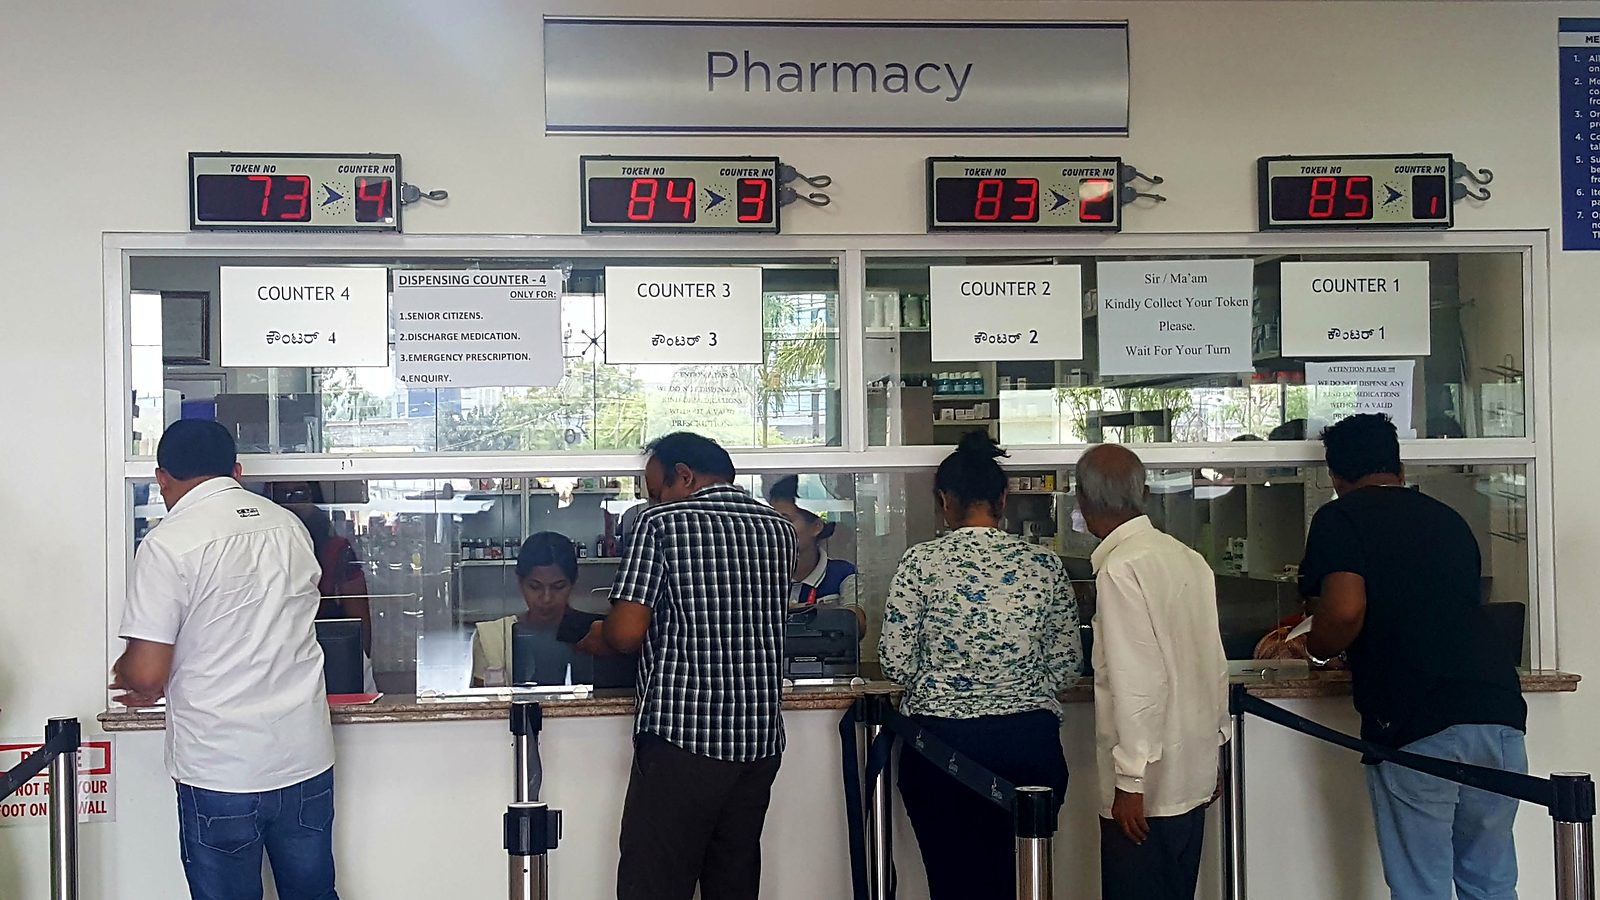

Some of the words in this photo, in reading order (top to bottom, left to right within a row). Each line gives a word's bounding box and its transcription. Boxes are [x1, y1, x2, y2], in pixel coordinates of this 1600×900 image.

[706, 49, 974, 102] Pharmacy
[1574, 77, 1582, 85] 2.
[1574, 110, 1583, 118] 3.
[1589, 121, 1600, 129] pr
[1575, 133, 1584, 141] 4.
[1575, 155, 1584, 164] 5.
[230, 164, 260, 174] TOKEN
[262, 164, 276, 174] NO
[338, 164, 379, 174] COUNTER
[381, 165, 395, 174] NO
[621, 166, 650, 176] TOKEN
[652, 167, 665, 176] NO
[719, 168, 759, 178] COUNTER
[761, 168, 774, 178] NO
[964, 168, 993, 176] TOKEN
[994, 168, 1007, 176] NO
[1062, 168, 1101, 178] COUNTER
[1102, 168, 1115, 178] NO
[1300, 166, 1328, 175] TOKEN
[1329, 166, 1342, 175] NO
[1394, 165, 1433, 174] COUNTER
[1434, 165, 1446, 174] NO
[247, 175, 310, 219] 73
[358, 177, 388, 218] 4
[1308, 177, 1369, 218] 85
[1576, 188, 1585, 196] 6.
[627, 178, 695, 221] 84
[738, 178, 767, 221] 3
[974, 179, 1038, 221] 83
[1080, 178, 1108, 221] 2
[1577, 211, 1584, 219] 7.
[399, 274, 470, 285] DISPENSING
[473, 274, 529, 285] COUNTER
[539, 274, 547, 285] 4
[1144, 273, 1161, 284] Sir
[1162, 273, 1168, 284] /
[1170, 273, 1208, 284] Ma'am
[637, 283, 716, 298] COUNTER
[722, 283, 731, 298] 3
[960, 281, 1037, 296] COUNTER
[1042, 281, 1051, 296] 2
[1311, 278, 1387, 293] COUNTER
[1393, 278, 1400, 292] 1
[257, 286, 335, 301] COUNTER
[340, 286, 350, 301] 4
[510, 290, 534, 299] ONLY
[536, 290, 557, 298] FOR:
[1105, 298, 1141, 311] Kindly
[1144, 297, 1182, 309] Collect
[1185, 297, 1212, 308] Your
[1215, 296, 1249, 307] Token
[399, 312, 440, 320] 1.SENIOR
[442, 311, 484, 320] CITIZENS.
[1159, 320, 1196, 331] Please.
[327, 332, 337, 344] 4
[399, 332, 458, 341] 2.DISCHARGE
[460, 332, 521, 341] MEDICATION.
[1029, 330, 1039, 344] 2
[1378, 326, 1385, 340] 1
[708, 332, 718, 346] 3
[1125, 345, 1151, 356] Wait
[1154, 345, 1172, 356] For
[1175, 345, 1201, 355] Your
[1205, 344, 1231, 355] Turn
[400, 353, 464, 362] 3.EMERGENCY
[465, 352, 531, 361] PRESCRIPTION.
[400, 374, 452, 384] 4.ENQUIRY.
[15, 782, 40, 797] NOT
[0, 803, 26, 817] OOT
[29, 802, 47, 816] ON
